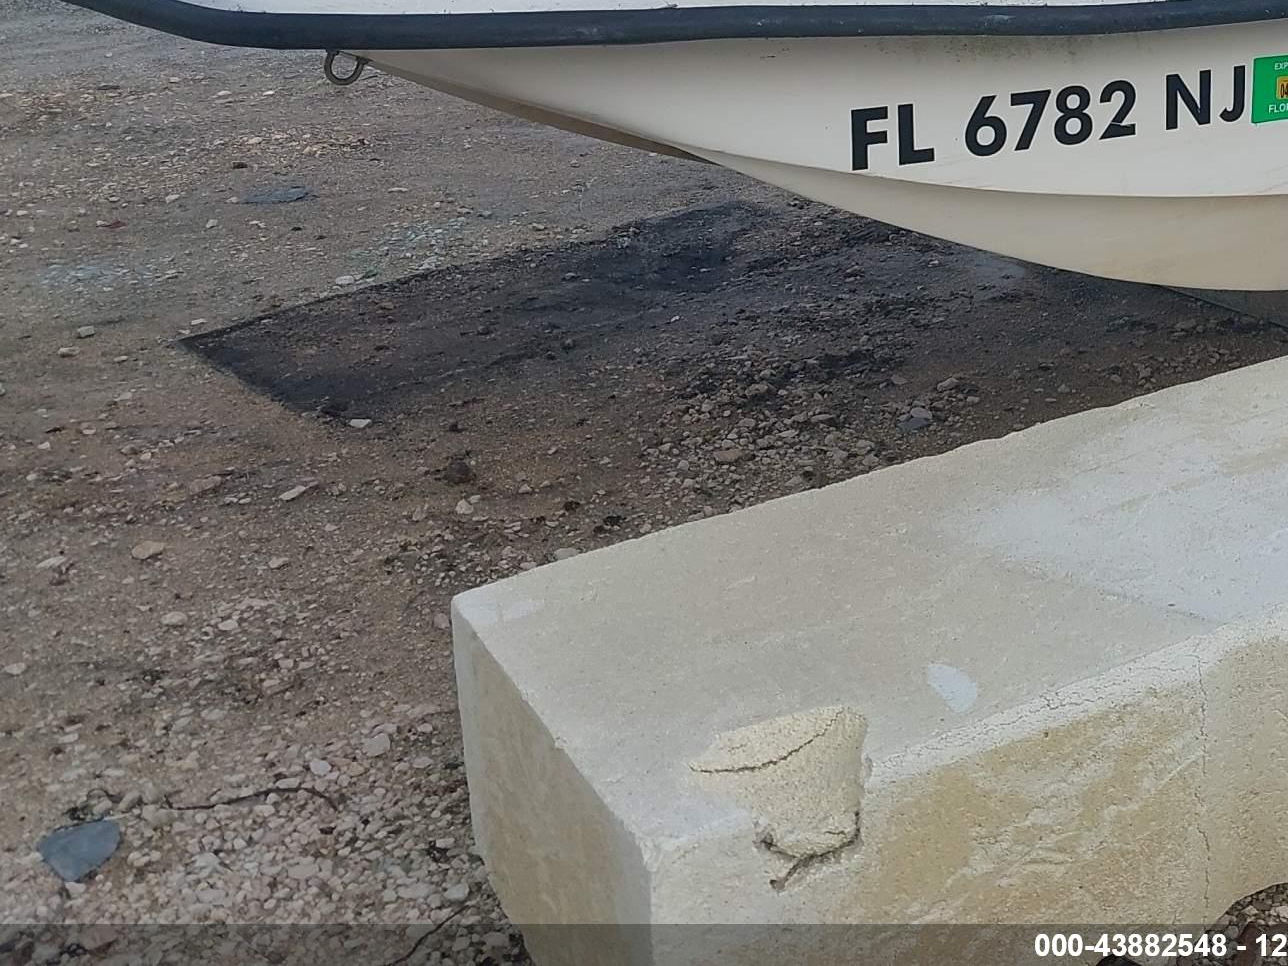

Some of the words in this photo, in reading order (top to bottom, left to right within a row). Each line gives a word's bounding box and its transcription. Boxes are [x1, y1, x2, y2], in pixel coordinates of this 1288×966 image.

[851, 103, 935, 171] FL
[964, 80, 1136, 157] 6782
[1166, 65, 1246, 131] NJ
